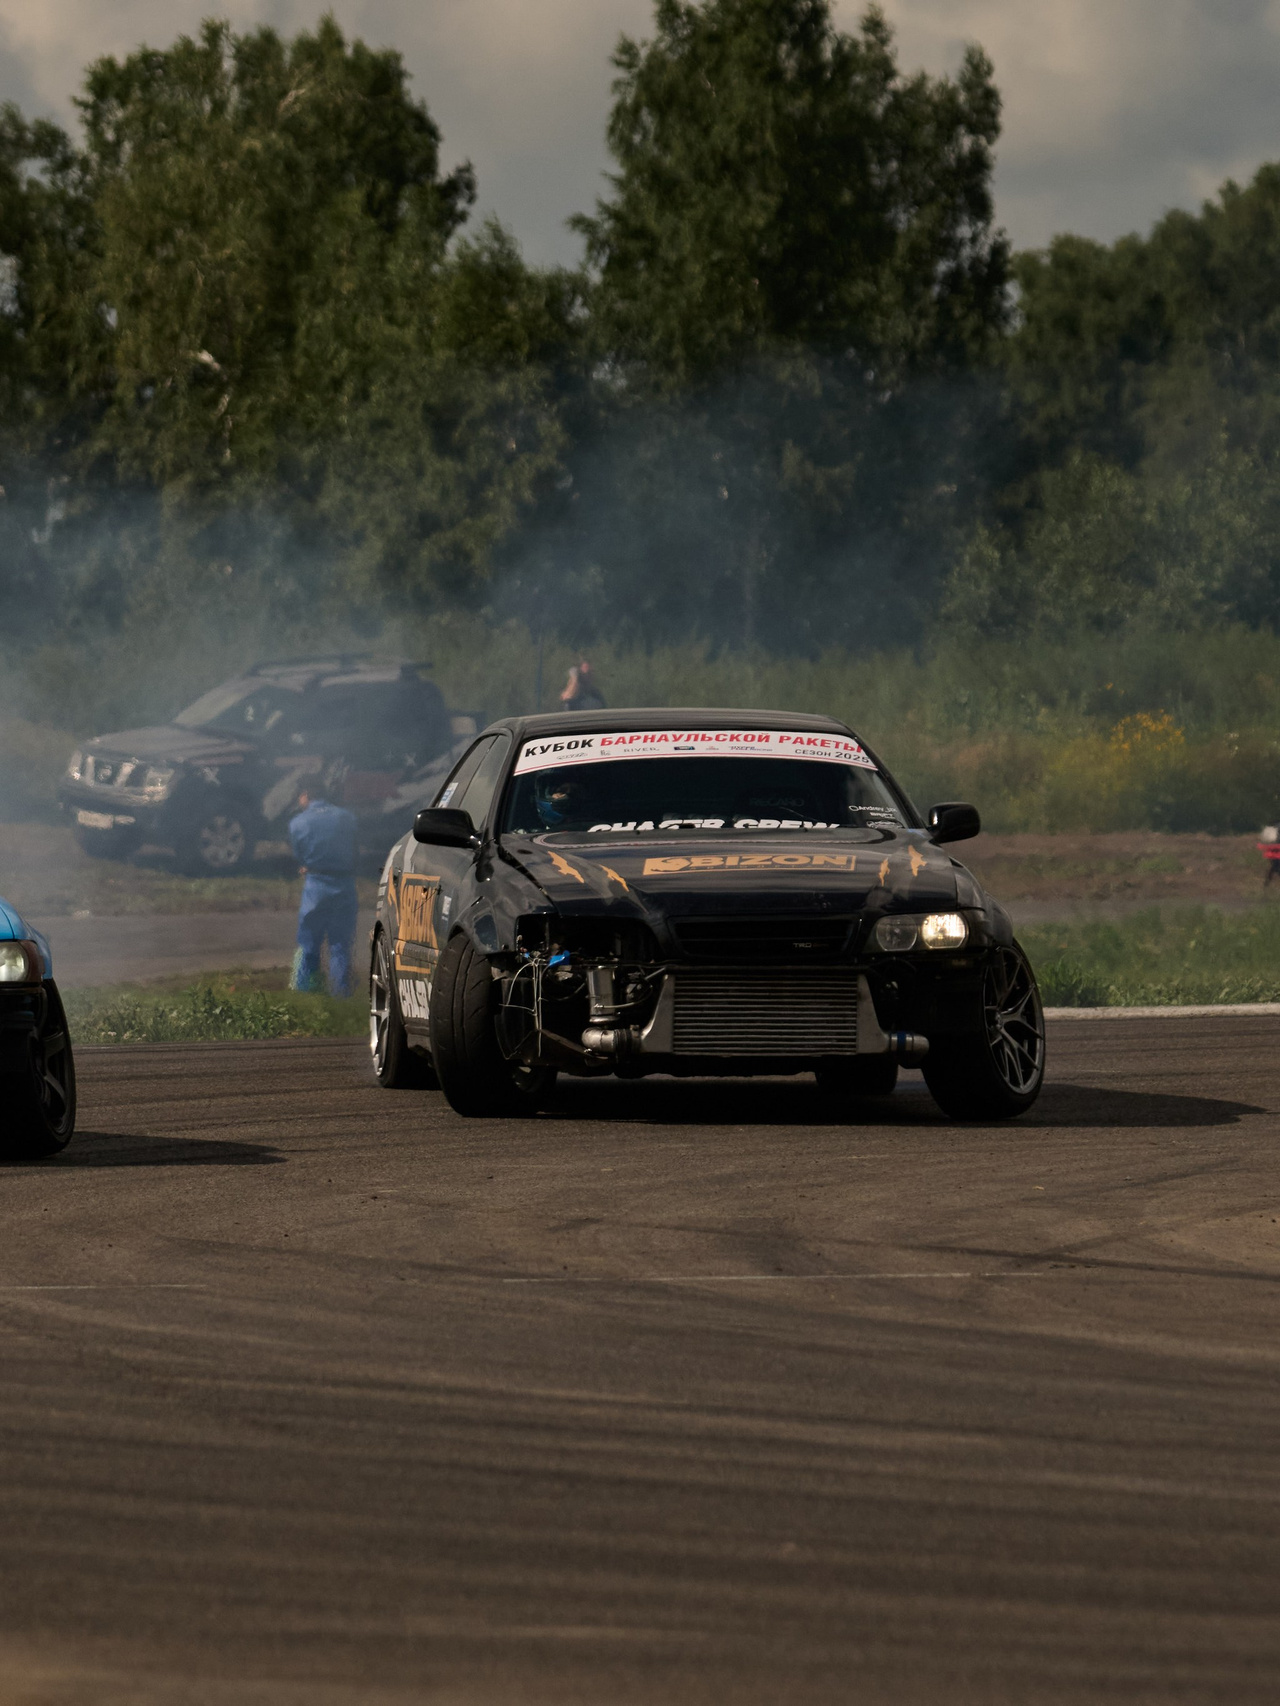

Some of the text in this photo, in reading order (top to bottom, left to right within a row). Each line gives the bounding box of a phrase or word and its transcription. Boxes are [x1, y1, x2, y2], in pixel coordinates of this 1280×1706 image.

[525, 738, 595, 758] КУБОК
[600, 732, 771, 747] БАРНАУЛЬСКОЙ
[778, 735, 863, 753] РАКЕТЫ
[794, 748, 870, 764] СЕЗОН 2025
[689, 854, 847, 867] BIZON
